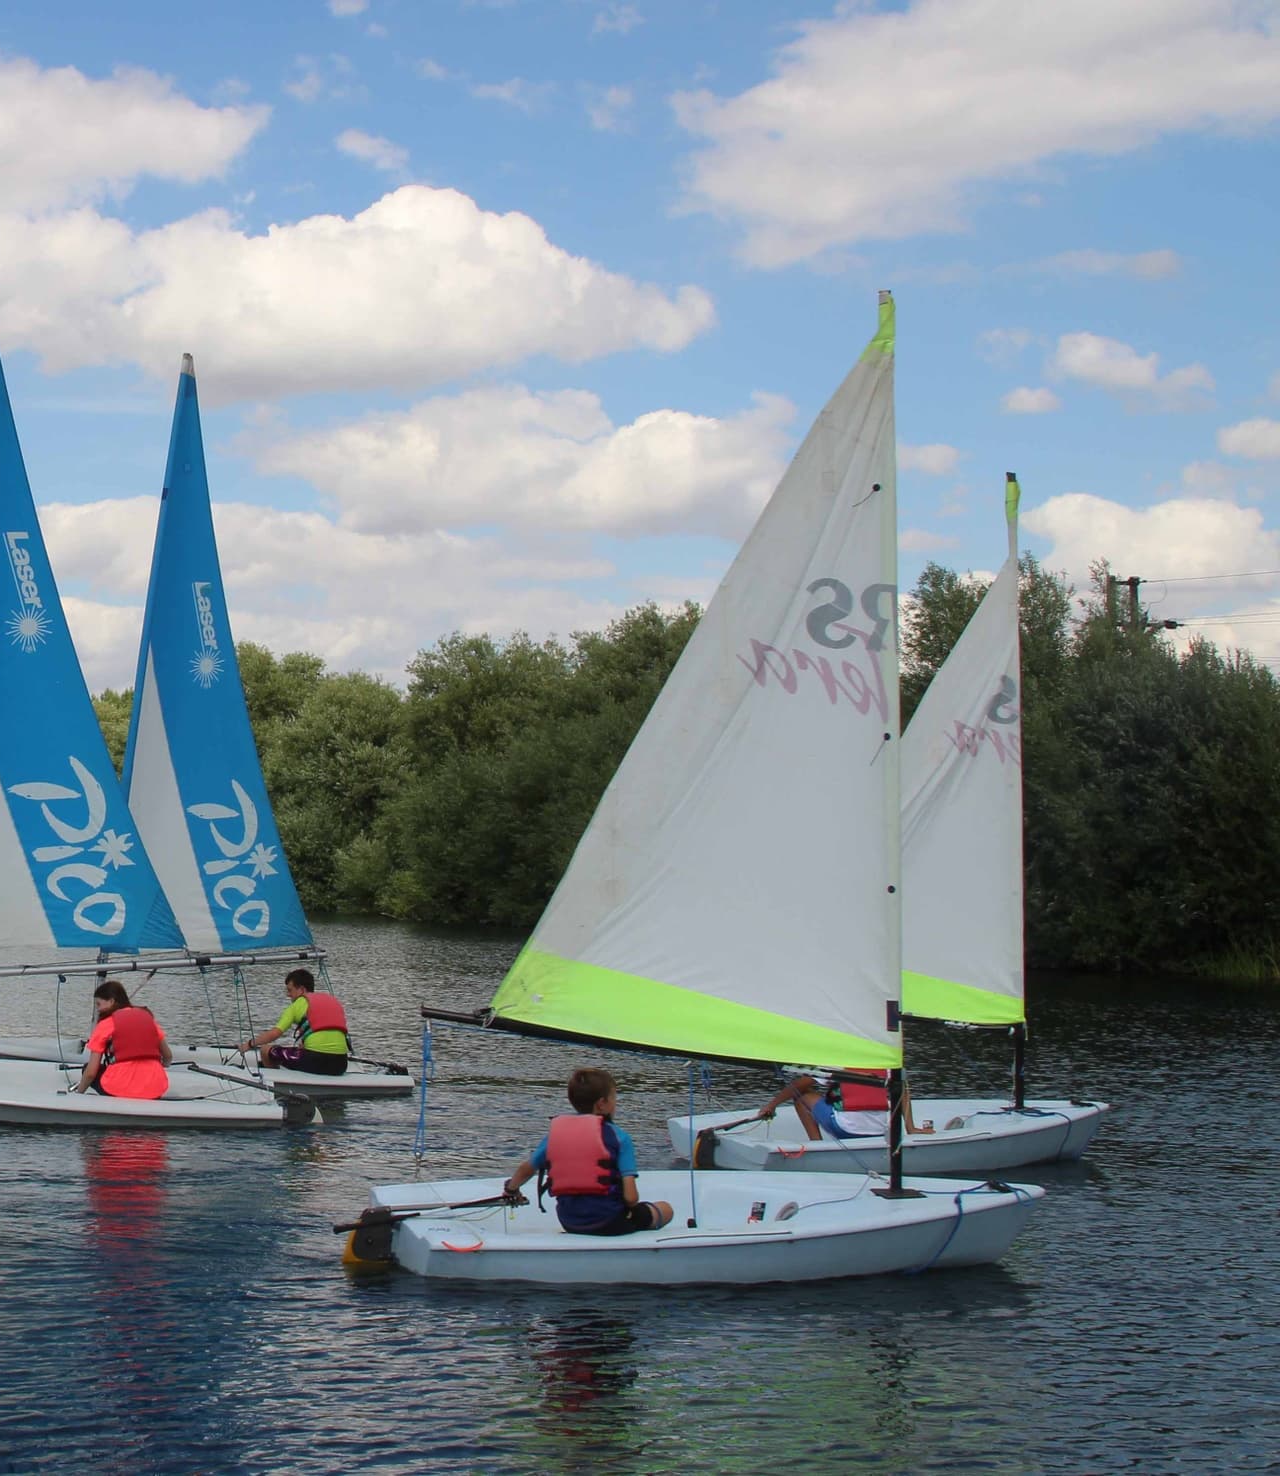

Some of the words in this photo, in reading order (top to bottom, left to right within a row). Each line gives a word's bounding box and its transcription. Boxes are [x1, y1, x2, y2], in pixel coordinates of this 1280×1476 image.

[6, 531, 43, 608] Laser
[194, 582, 218, 649] Laser
[7, 755, 136, 936] Pico
[187, 779, 279, 938] Pico
